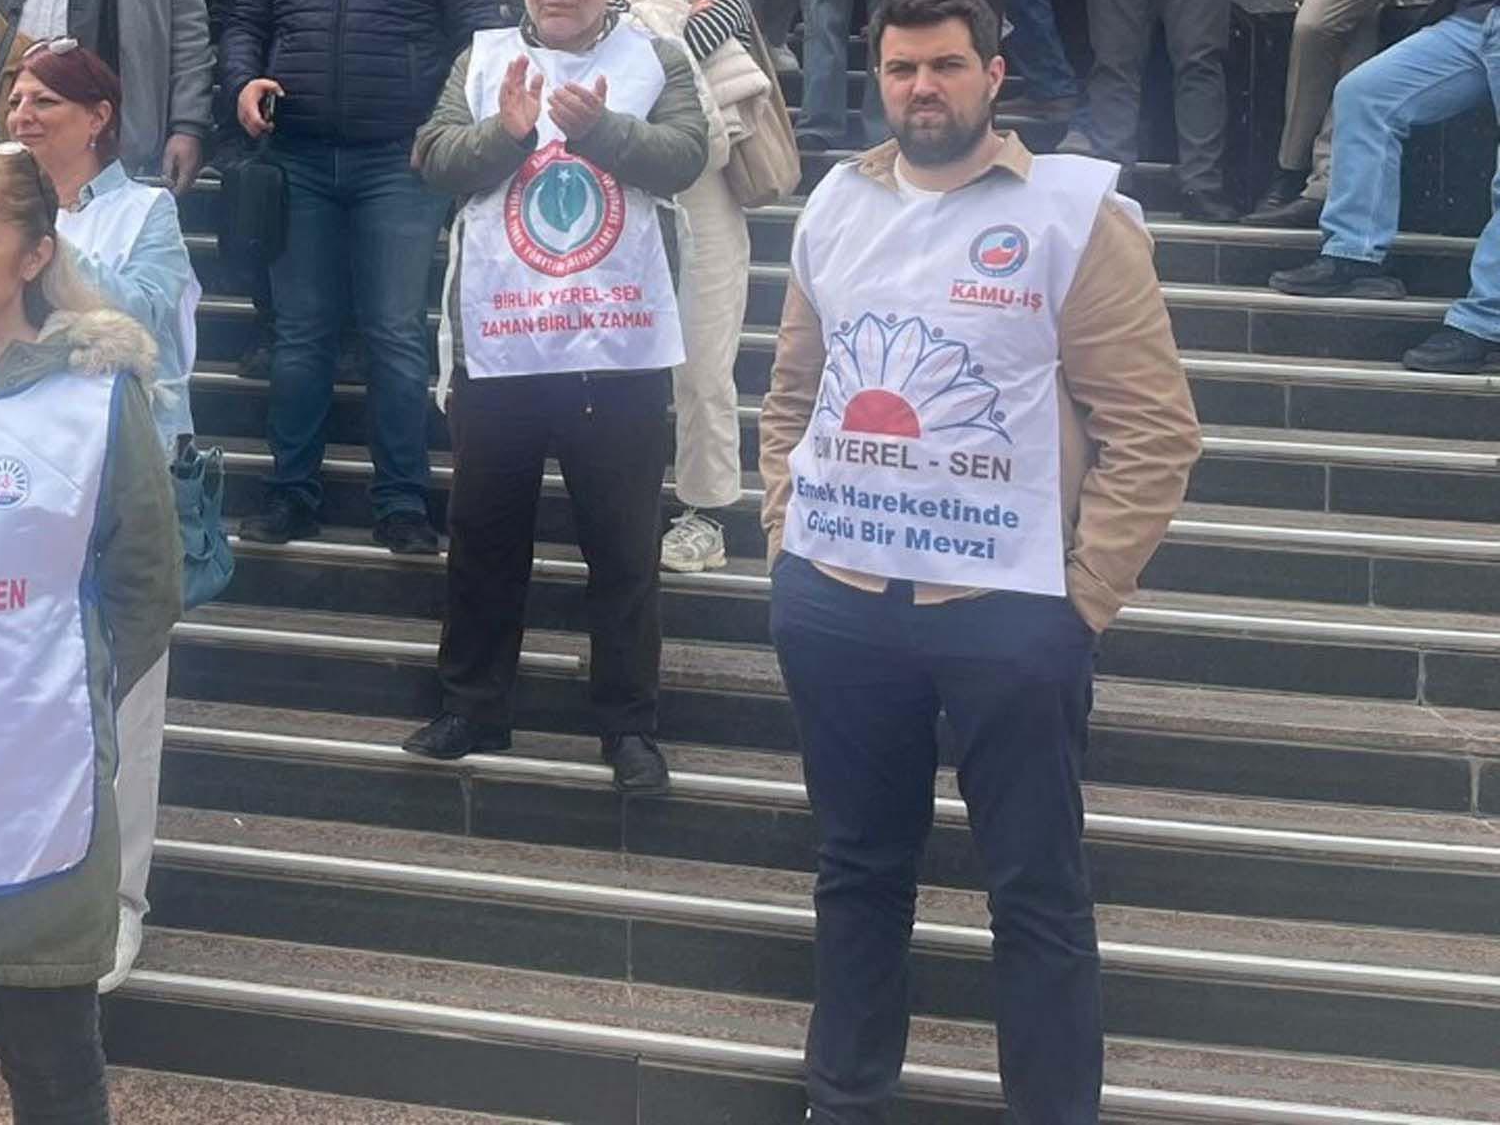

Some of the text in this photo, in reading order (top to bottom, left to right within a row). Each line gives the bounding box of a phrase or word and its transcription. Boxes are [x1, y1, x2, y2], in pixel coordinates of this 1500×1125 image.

[493, 287, 544, 310] BİRLİK
[539, 311, 596, 333] BİRLİK
[949, 451, 1012, 482] SEN
[841, 483, 1019, 528] Hareketinde
[861, 520, 896, 545] Bir
[905, 527, 996, 560] Mevzi
